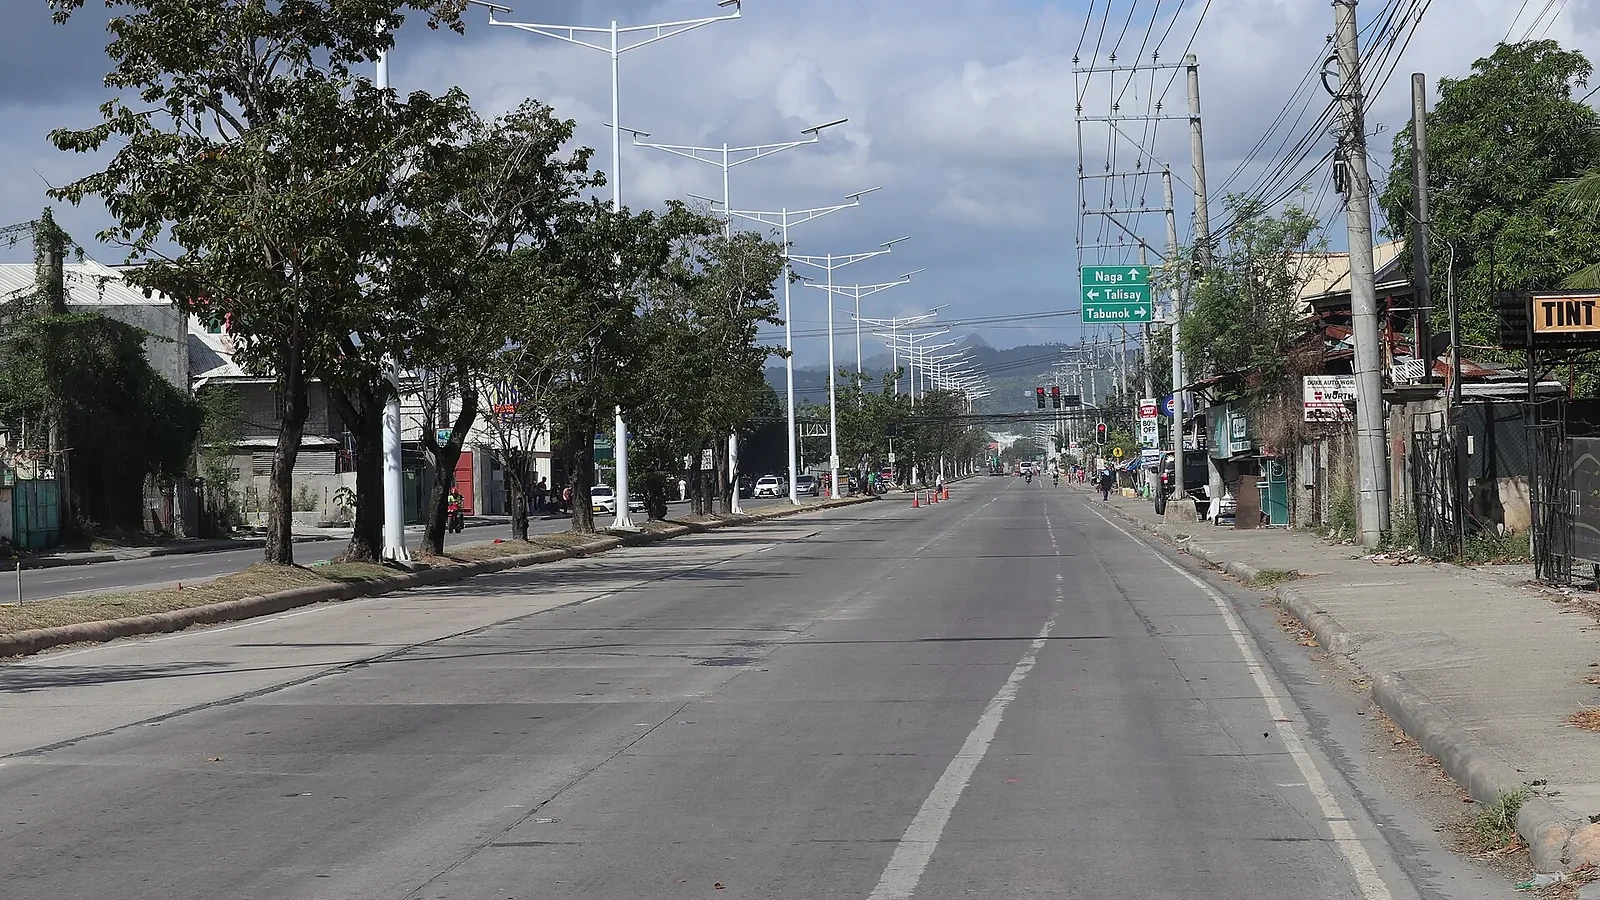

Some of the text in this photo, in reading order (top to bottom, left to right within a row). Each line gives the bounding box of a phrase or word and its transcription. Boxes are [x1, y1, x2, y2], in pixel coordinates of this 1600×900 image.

[1095, 271, 1123, 284] Naga
[1104, 289, 1141, 302] Talisay
[1086, 308, 1130, 318] Tabunok
[1542, 301, 1595, 326] TINT
[1142, 419, 1156, 427] 80%
